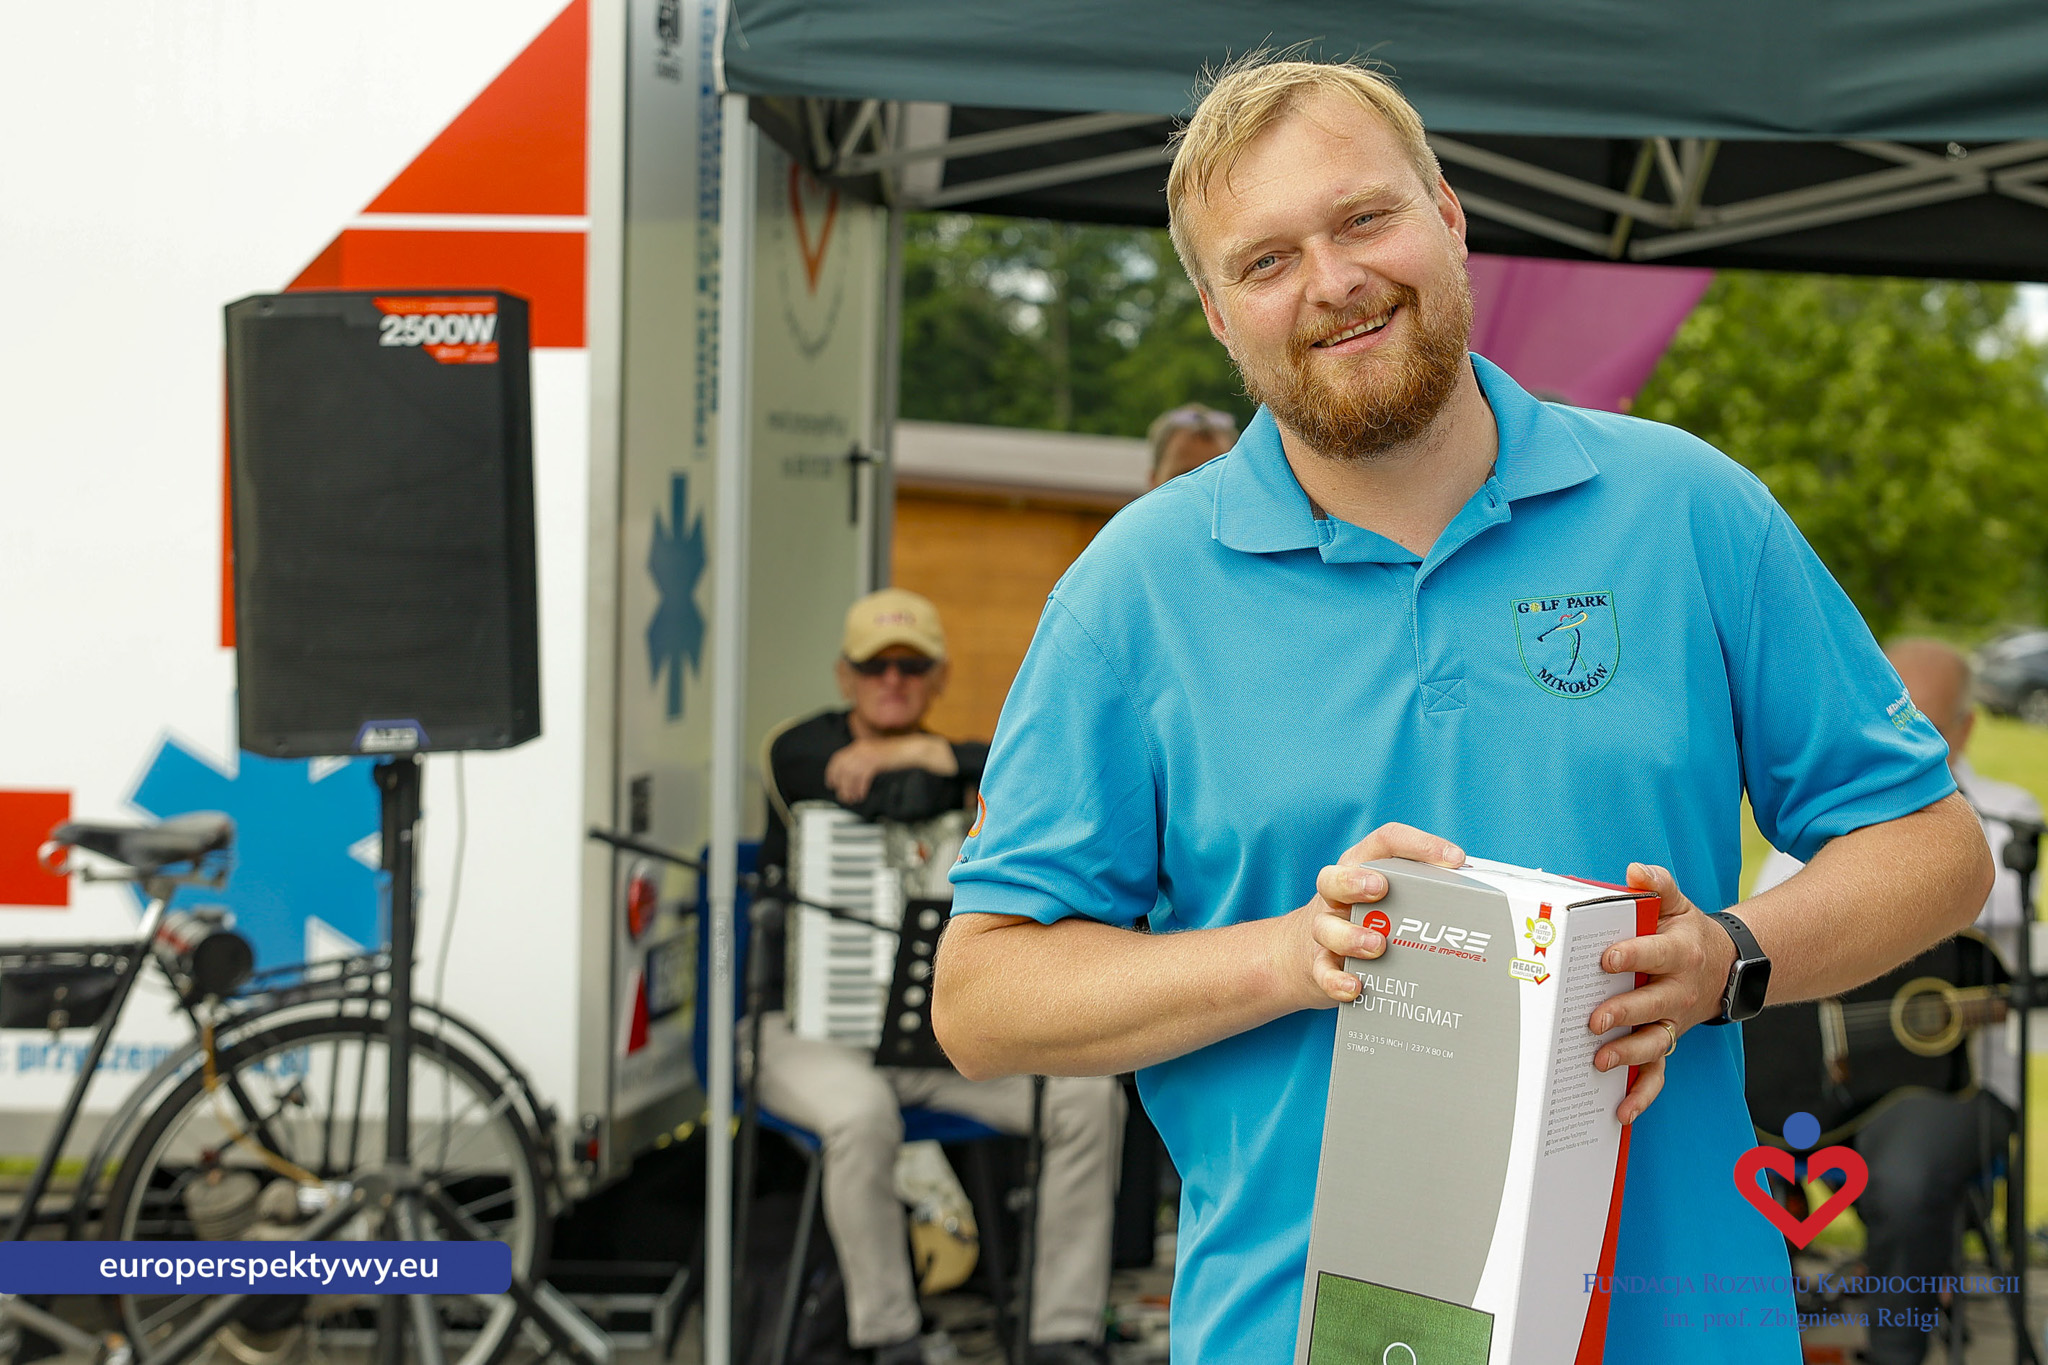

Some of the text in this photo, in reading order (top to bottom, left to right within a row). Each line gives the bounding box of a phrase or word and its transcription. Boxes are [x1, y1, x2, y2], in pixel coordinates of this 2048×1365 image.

[379, 313, 498, 346] 2500W
[1517, 595, 1608, 613] GOLF PARK
[1537, 663, 1608, 694] MIKOŁÓW
[1395, 917, 1492, 954] PURE
[1438, 948, 1482, 961] IMPROVE
[1512, 961, 1543, 975] REACH
[1355, 971, 1419, 999] TALENT
[1352, 993, 1463, 1030] PUTTINGMAT
[1346, 1042, 1375, 1055] STIMP 9
[1348, 1030, 1363, 1040] 93.3
[1370, 1035, 1385, 1044] 31.5
[1386, 1038, 1403, 1049] INCH
[1411, 1043, 1424, 1053] 237
[1431, 1048, 1441, 1056] 80
[1442, 1050, 1454, 1059] CM
